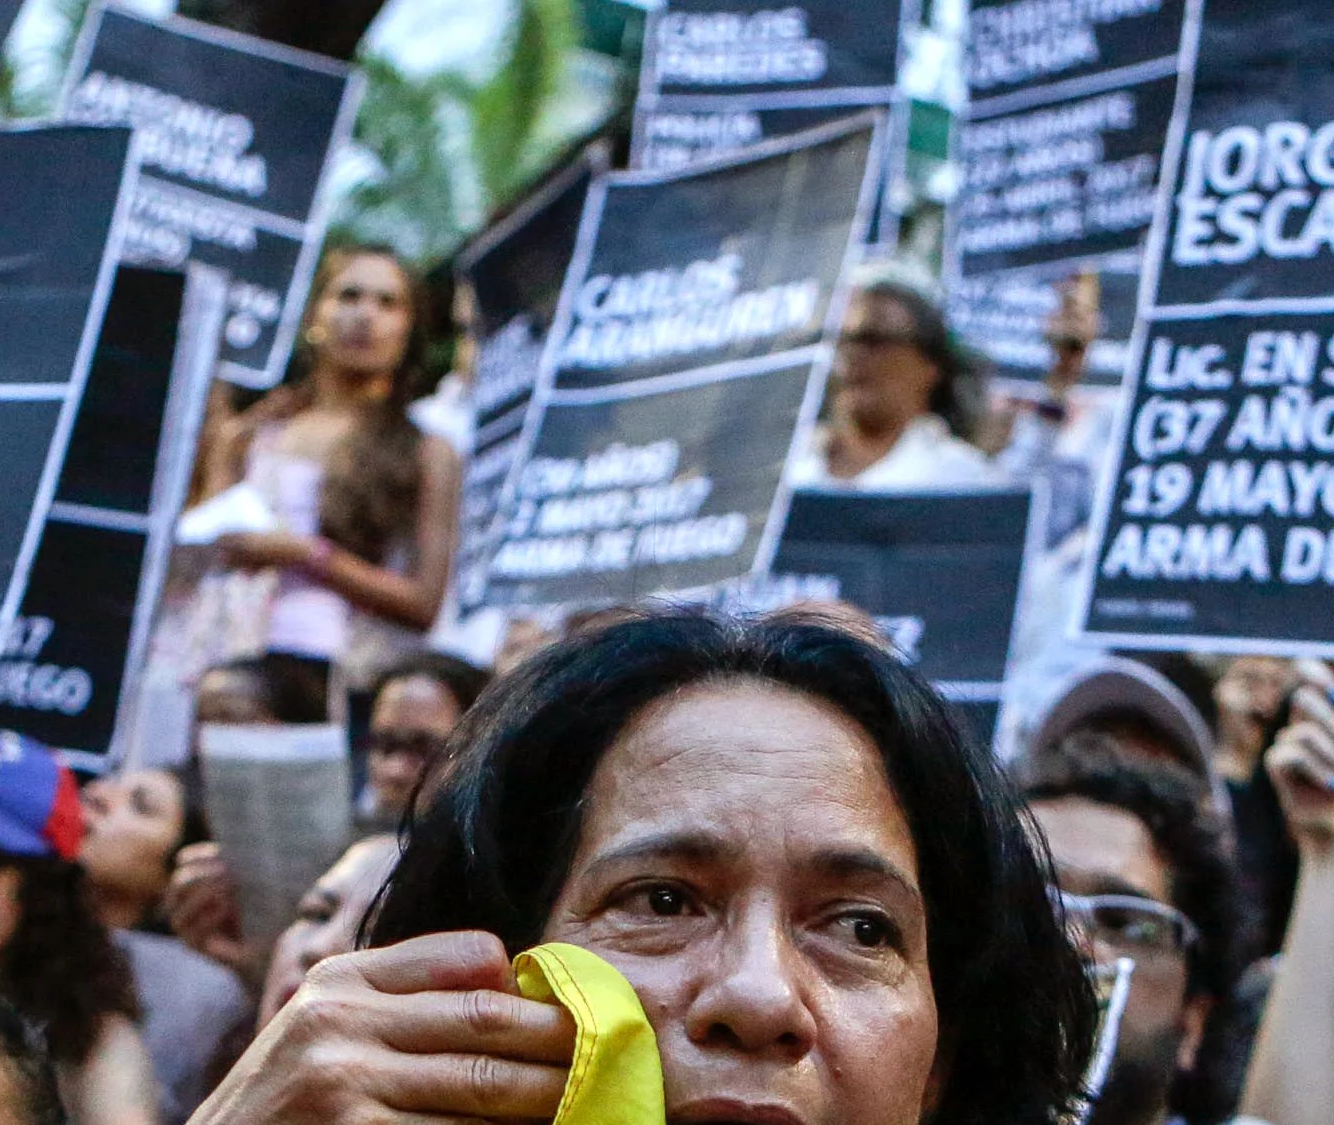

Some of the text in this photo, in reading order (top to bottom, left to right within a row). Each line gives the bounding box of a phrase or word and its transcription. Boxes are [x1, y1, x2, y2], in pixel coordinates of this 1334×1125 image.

[1241, 331, 1320, 387] EN
[1132, 396, 1227, 461] (37
[1122, 465, 1196, 516] 19
[1103, 524, 1272, 580] ARMA
